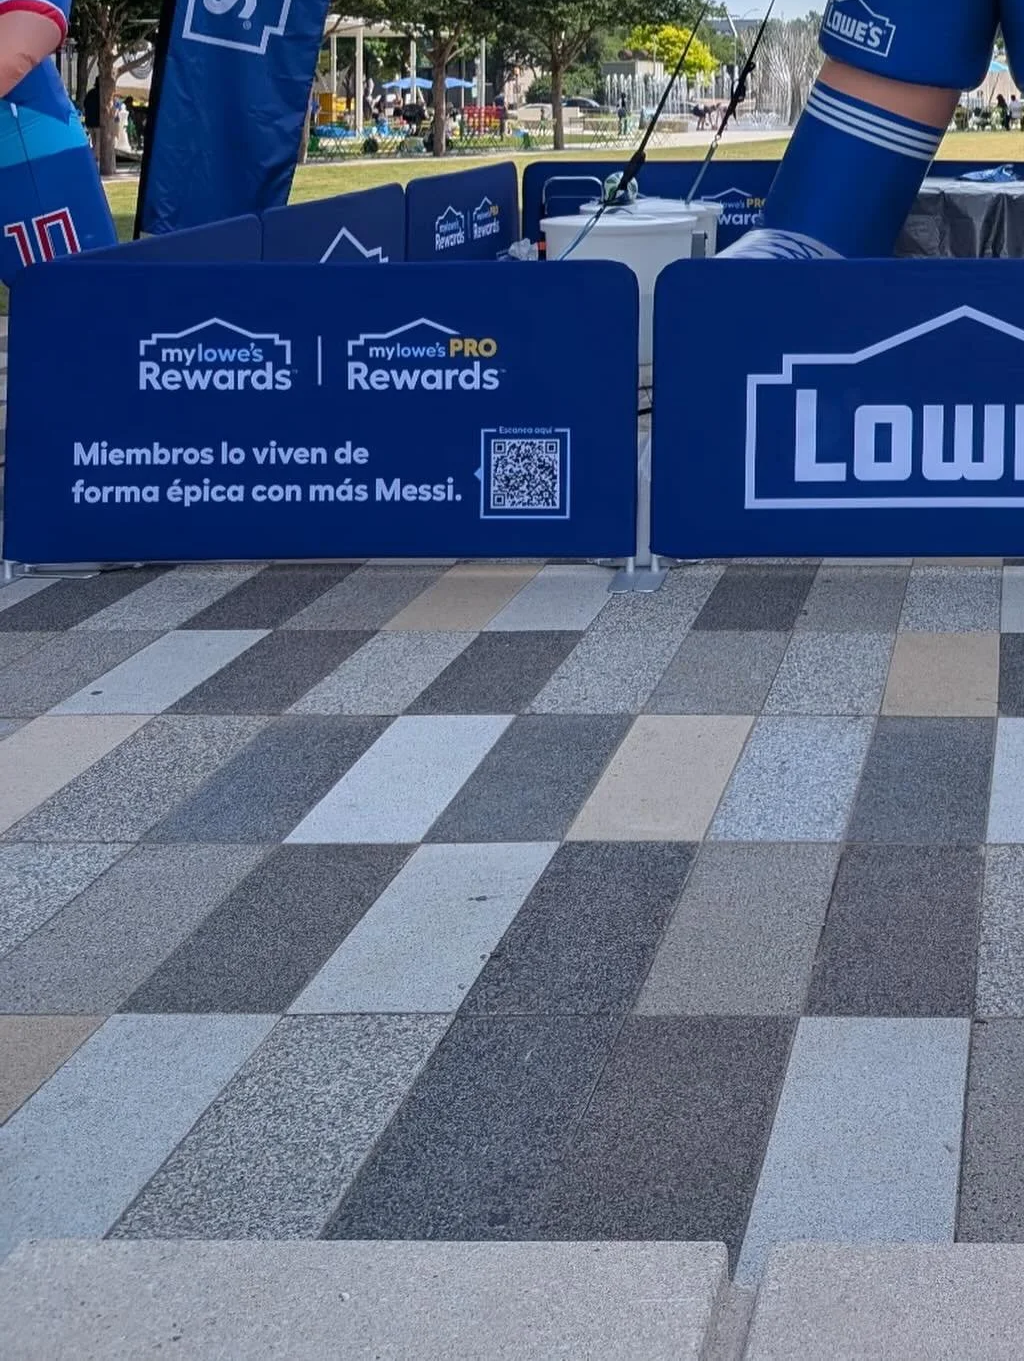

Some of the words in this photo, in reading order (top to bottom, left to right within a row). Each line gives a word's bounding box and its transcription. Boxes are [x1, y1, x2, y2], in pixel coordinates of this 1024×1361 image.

[826, 4, 883, 48] LOWE'S
[161, 342, 264, 366] mylowe's
[369, 342, 446, 360] mylowe's
[449, 338, 498, 358] PRO
[139, 361, 292, 390] Rewards
[347, 361, 500, 390] Rewards
[73, 441, 215, 466] Miembros
[221, 441, 246, 466] lo
[252, 441, 328, 465] viven
[334, 441, 370, 465] de
[72, 479, 160, 504] forma
[166, 477, 245, 507] épica
[251, 484, 302, 502] con
[309, 477, 369, 502] más
[375, 476, 462, 502] Messi.
